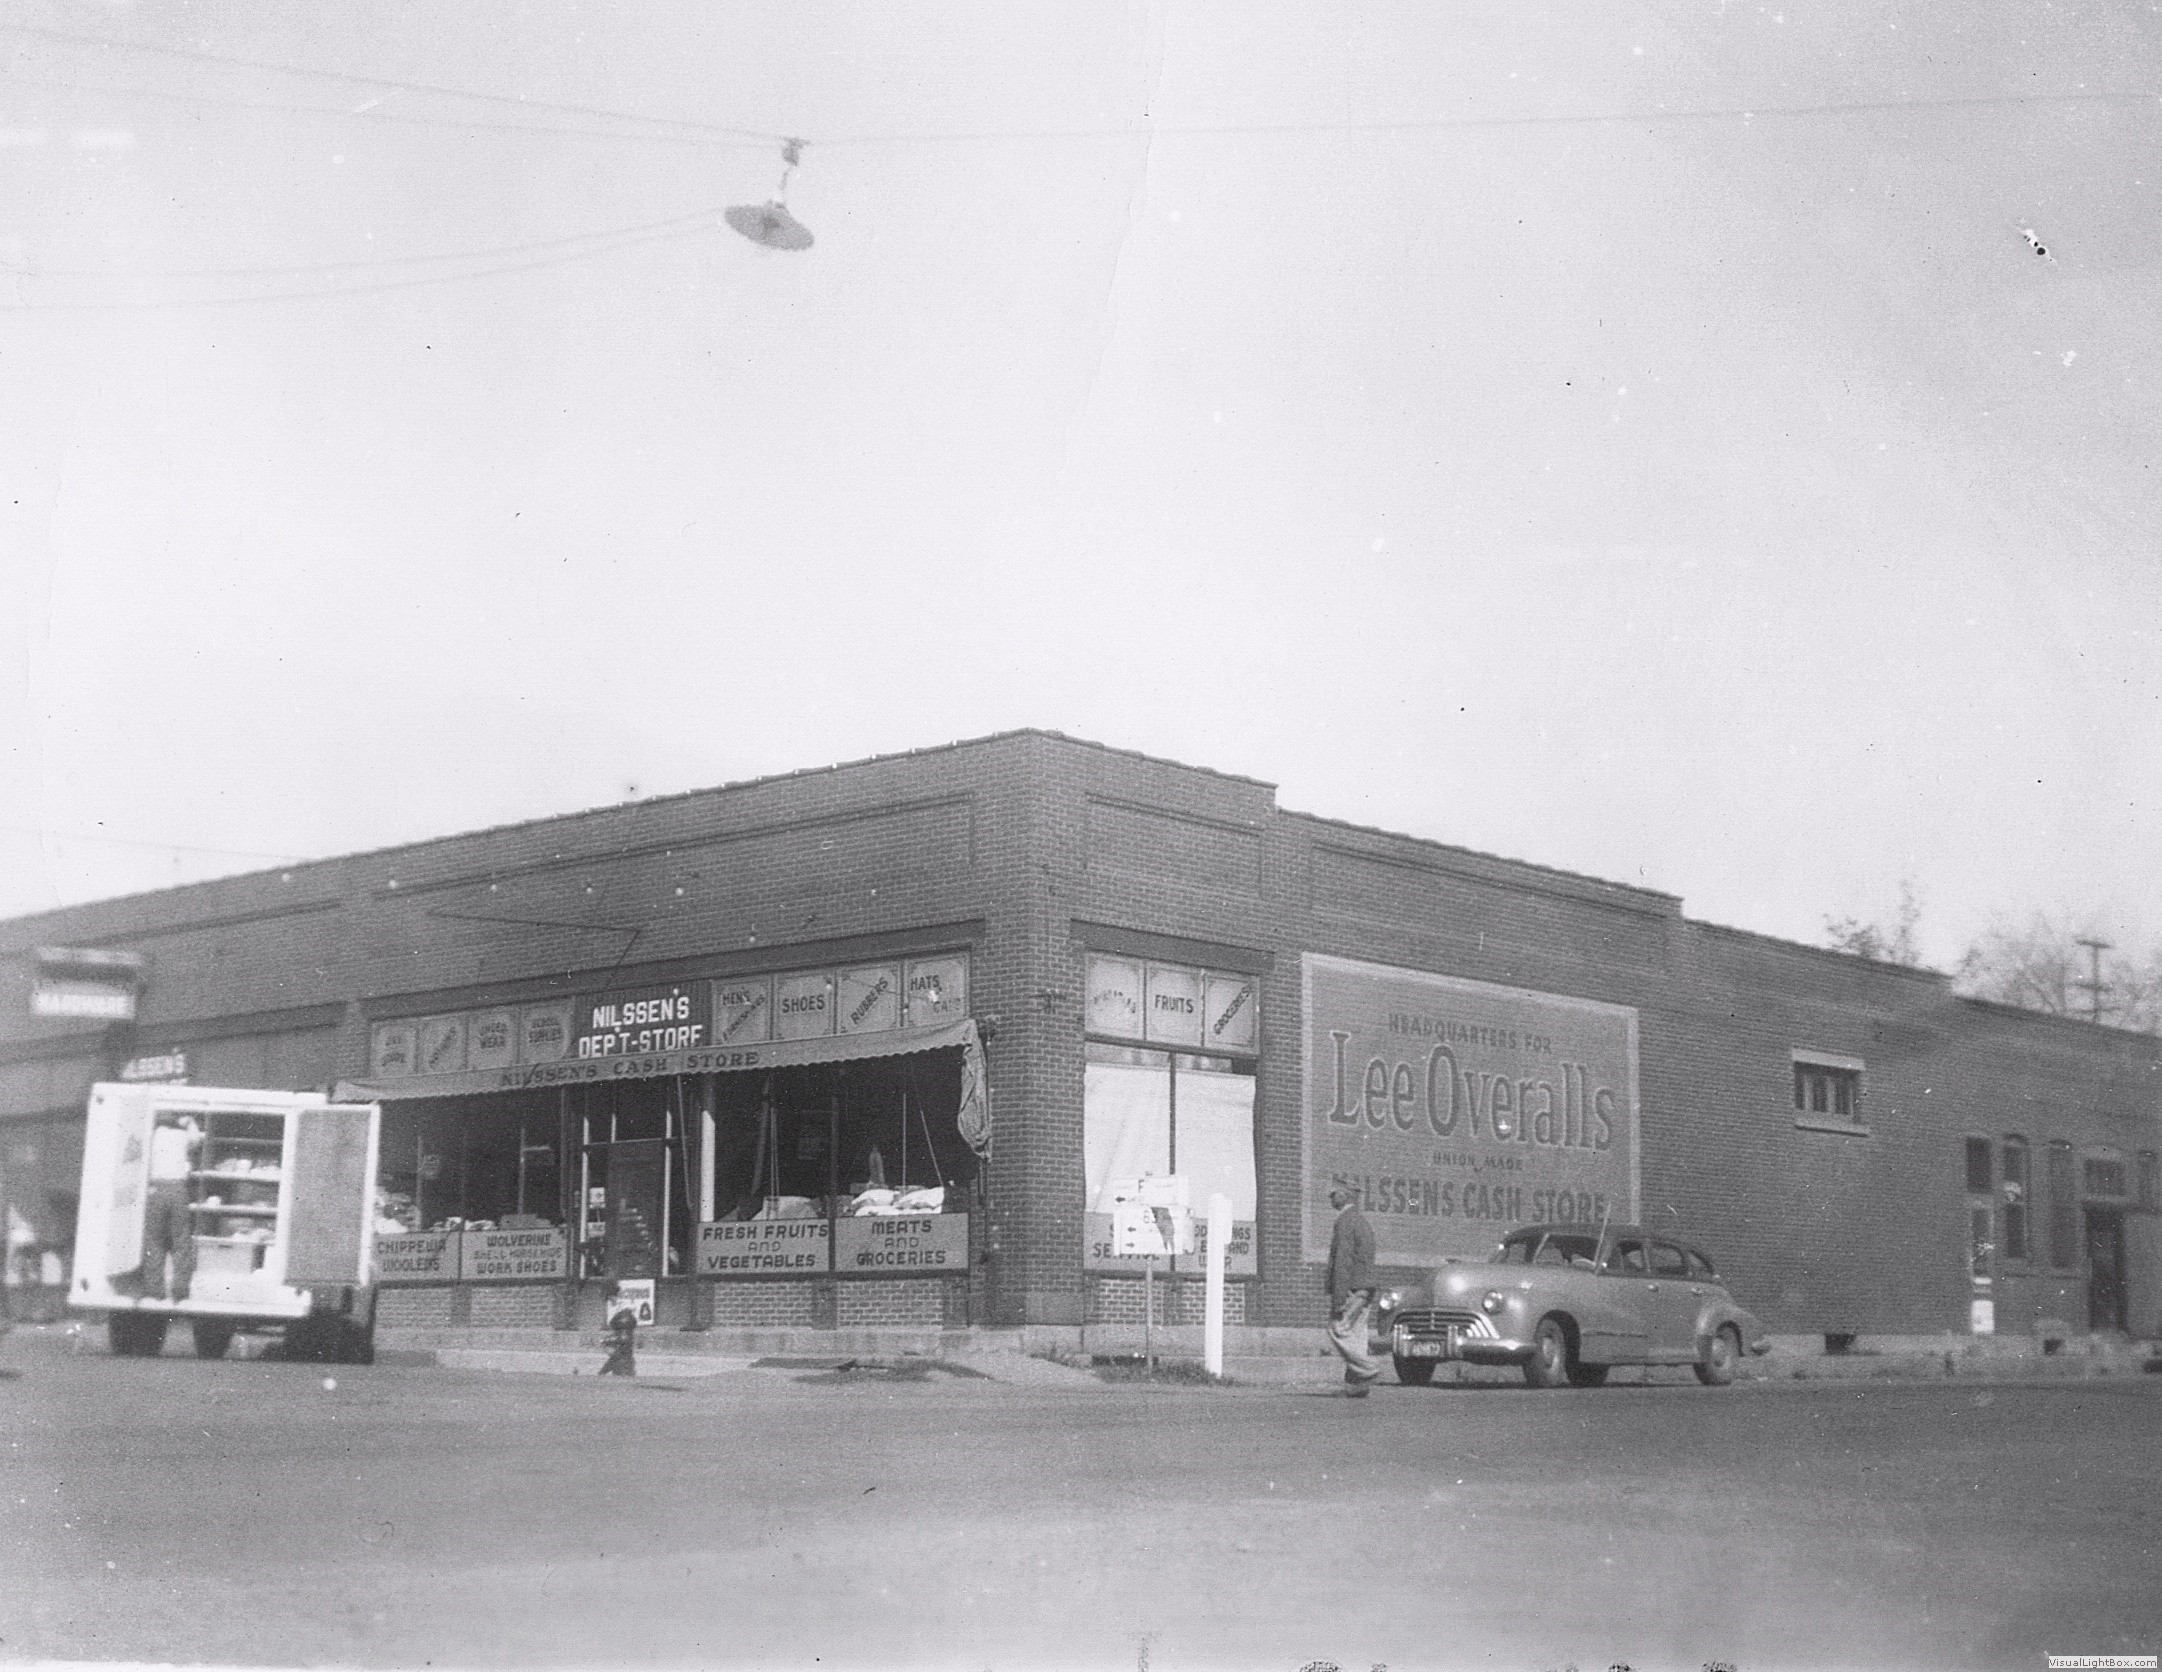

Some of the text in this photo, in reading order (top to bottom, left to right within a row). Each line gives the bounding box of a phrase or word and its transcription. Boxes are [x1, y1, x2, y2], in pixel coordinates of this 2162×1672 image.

[592, 988, 690, 1028] NILSSEN'S
[781, 993, 825, 1014] SHOES
[850, 976, 889, 1025] RUBBERS
[1155, 994, 1195, 1014] FRUITS
[1388, 1013, 1551, 1053] HEADQUARTERS FOR
[613, 1057, 668, 1076] CASH
[687, 1051, 760, 1070] STORE
[1328, 1030, 1615, 1151] Lee Overalls
[1432, 1153, 1524, 1171] UNION MADE
[1462, 1182, 1522, 1221] CASH
[1531, 1188, 1611, 1224] STORE
[703, 1222, 829, 1241] FRESH FRUITS
[871, 1219, 932, 1235] MEATS
[486, 1234, 552, 1247] WOLVERINE
[476, 1259, 558, 1275] WORK SHOES
[707, 1253, 816, 1271] VEGETABLES
[856, 1250, 947, 1267] GROCERIES
